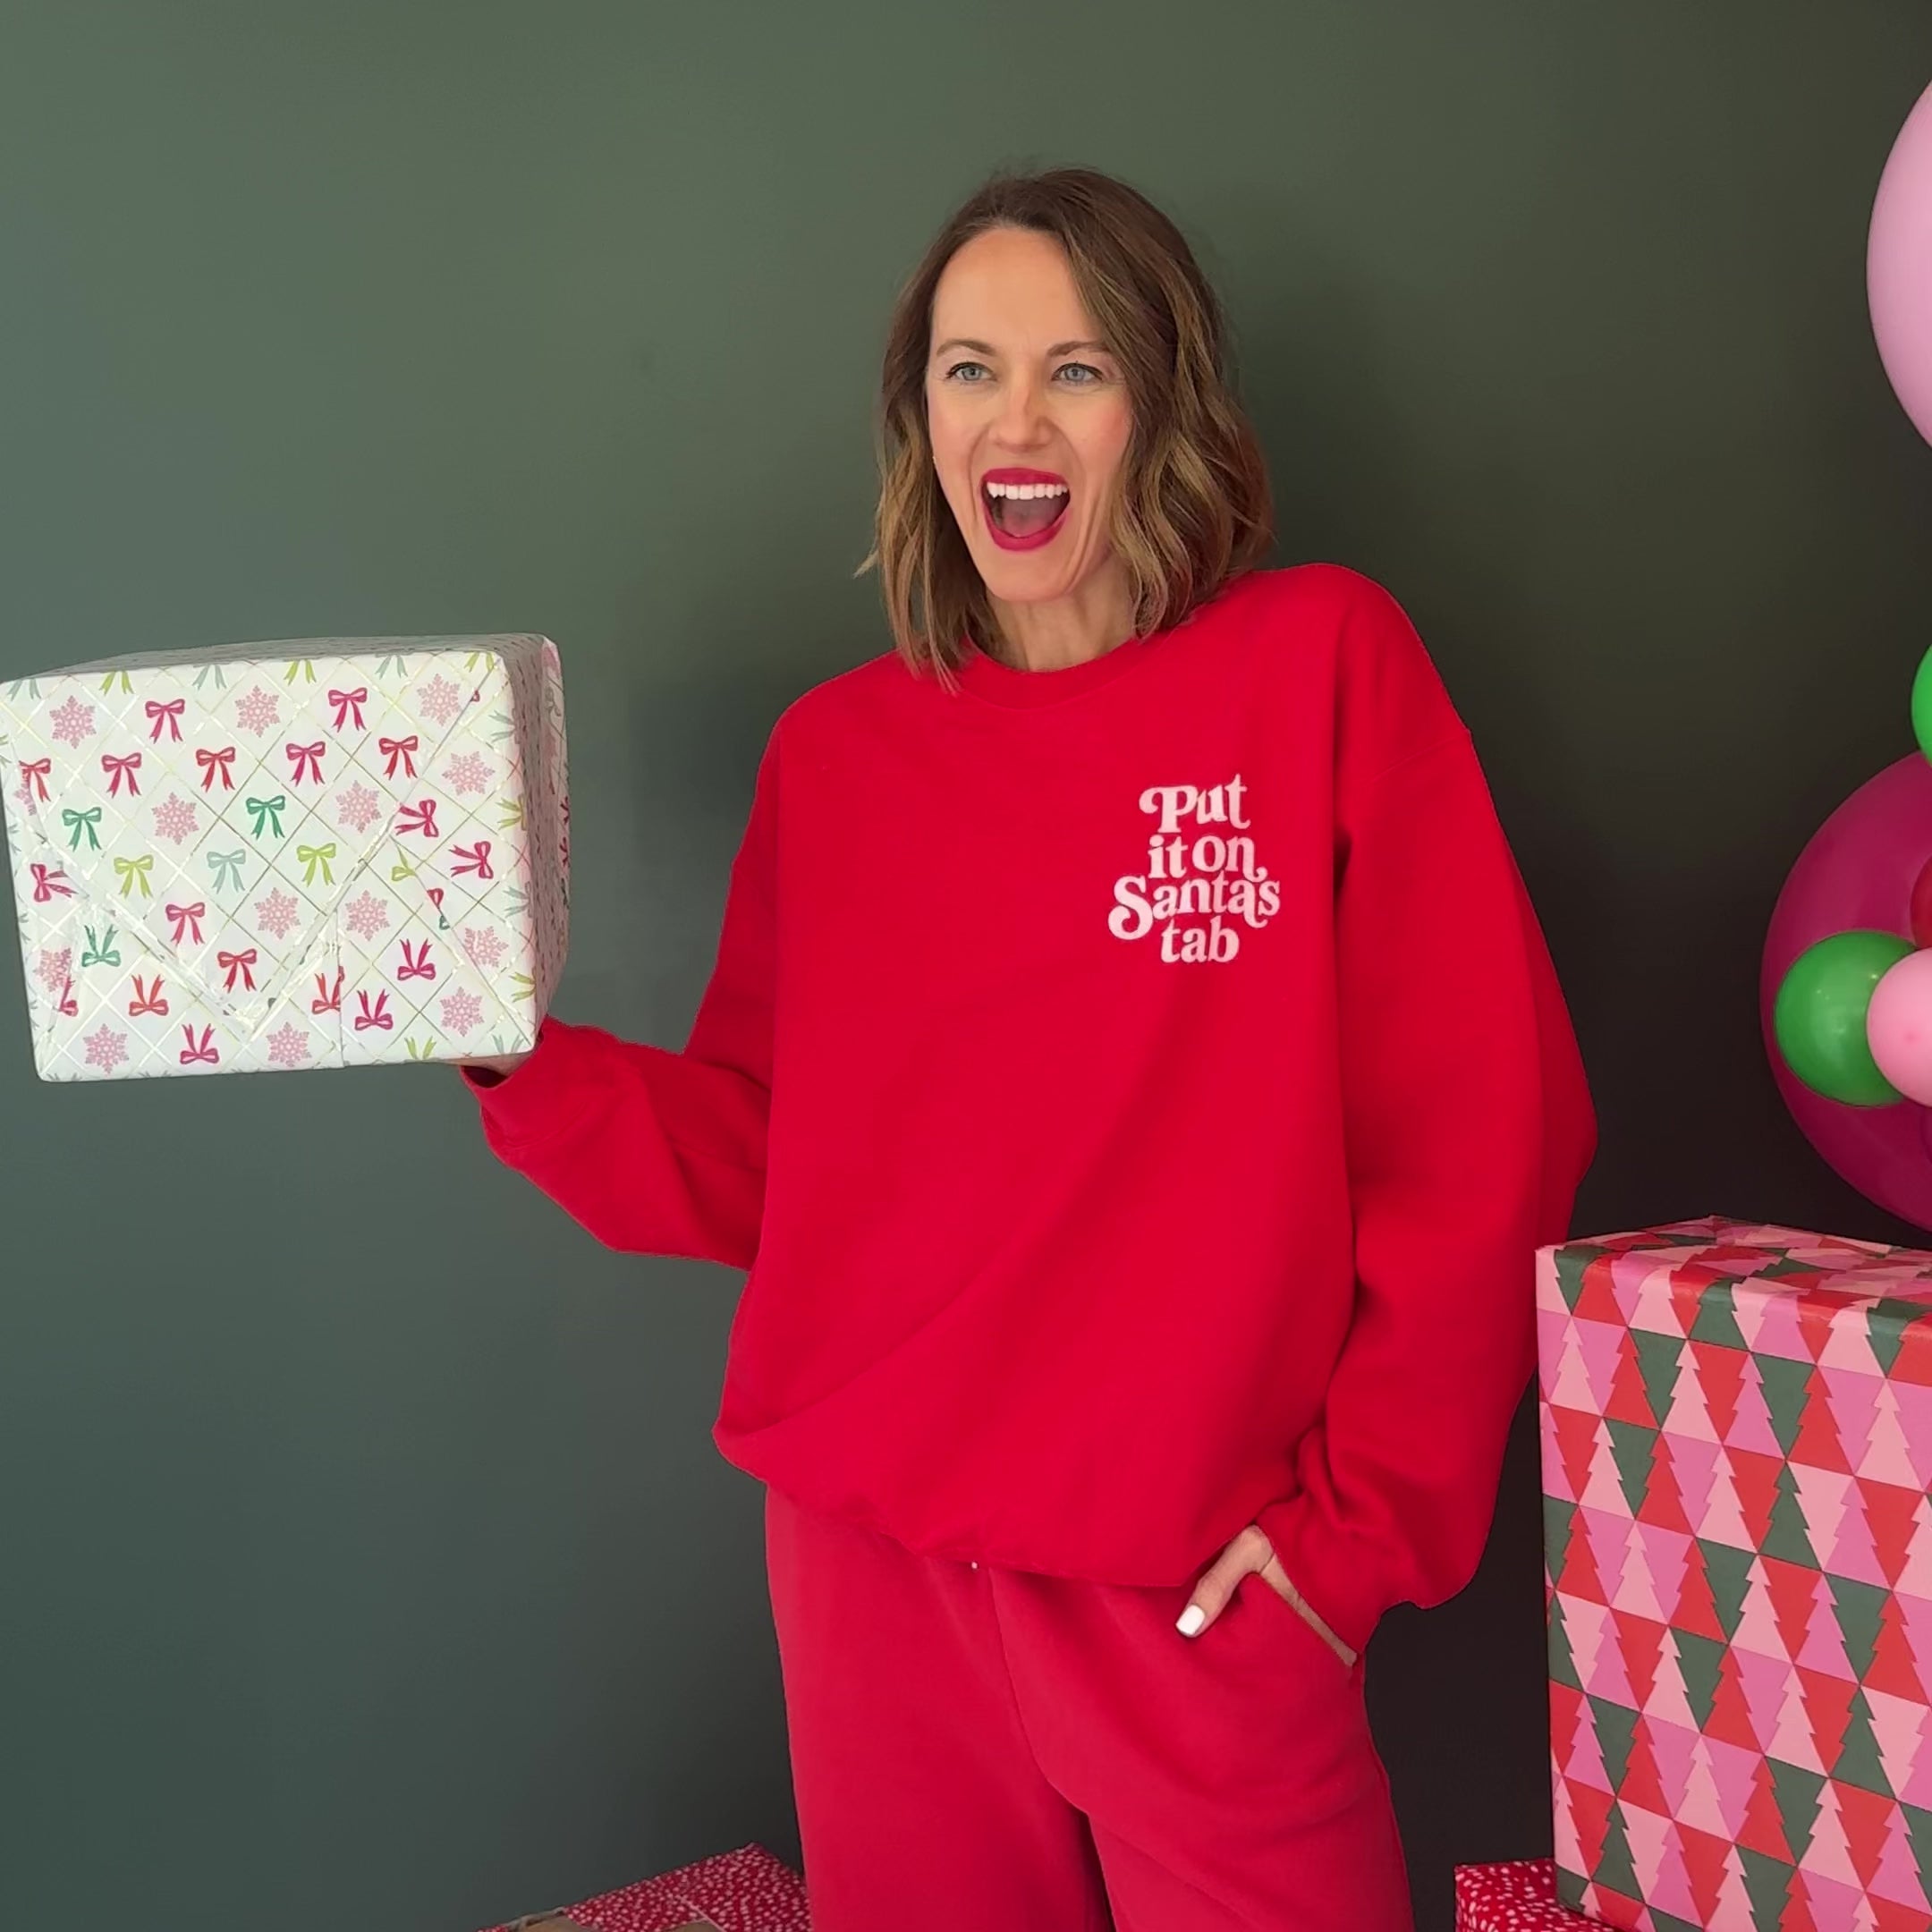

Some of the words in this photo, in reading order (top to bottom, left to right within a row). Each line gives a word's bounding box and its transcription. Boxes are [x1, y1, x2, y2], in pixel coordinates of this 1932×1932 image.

[1139, 773, 1251, 834] Put
[1148, 835, 1189, 879] it
[1191, 835, 1267, 883] on
[1160, 915, 1240, 963] tab
